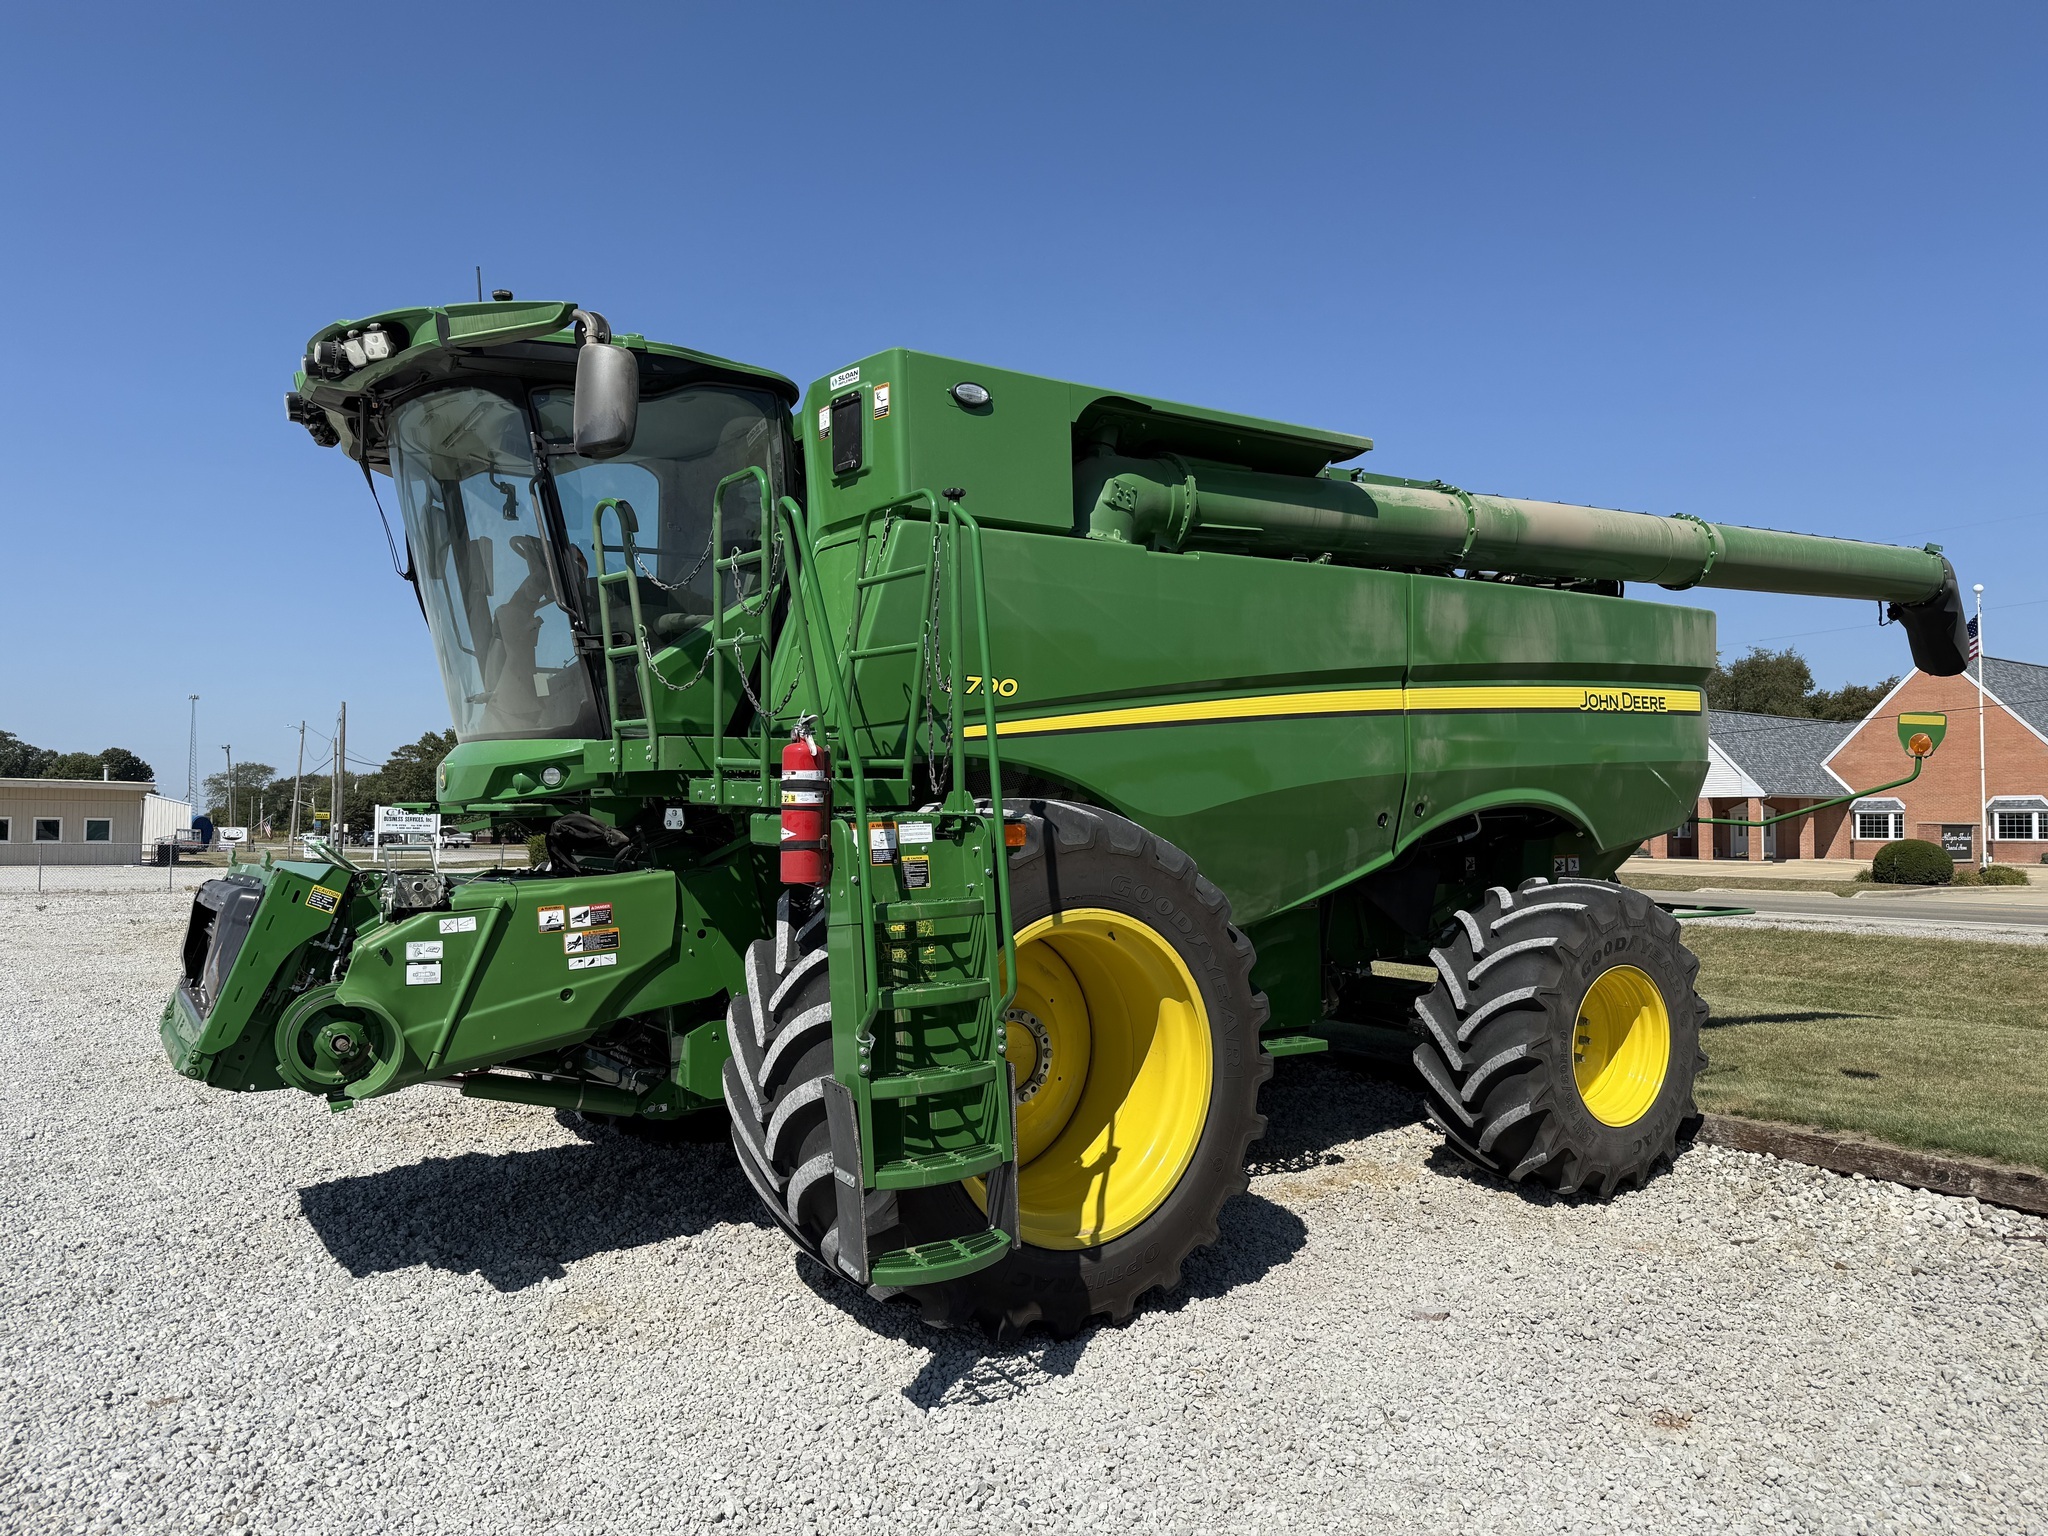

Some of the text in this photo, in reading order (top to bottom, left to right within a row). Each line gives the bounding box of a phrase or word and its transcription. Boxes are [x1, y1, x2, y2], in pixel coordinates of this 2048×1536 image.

[838, 370, 859, 382] SLOAN
[1580, 691, 1667, 710] JOHN DEERE
[317, 886, 340, 898] CAUTION
[1111, 875, 1241, 1068] GOODYEAR
[1581, 935, 1682, 993] GOODYEAR
